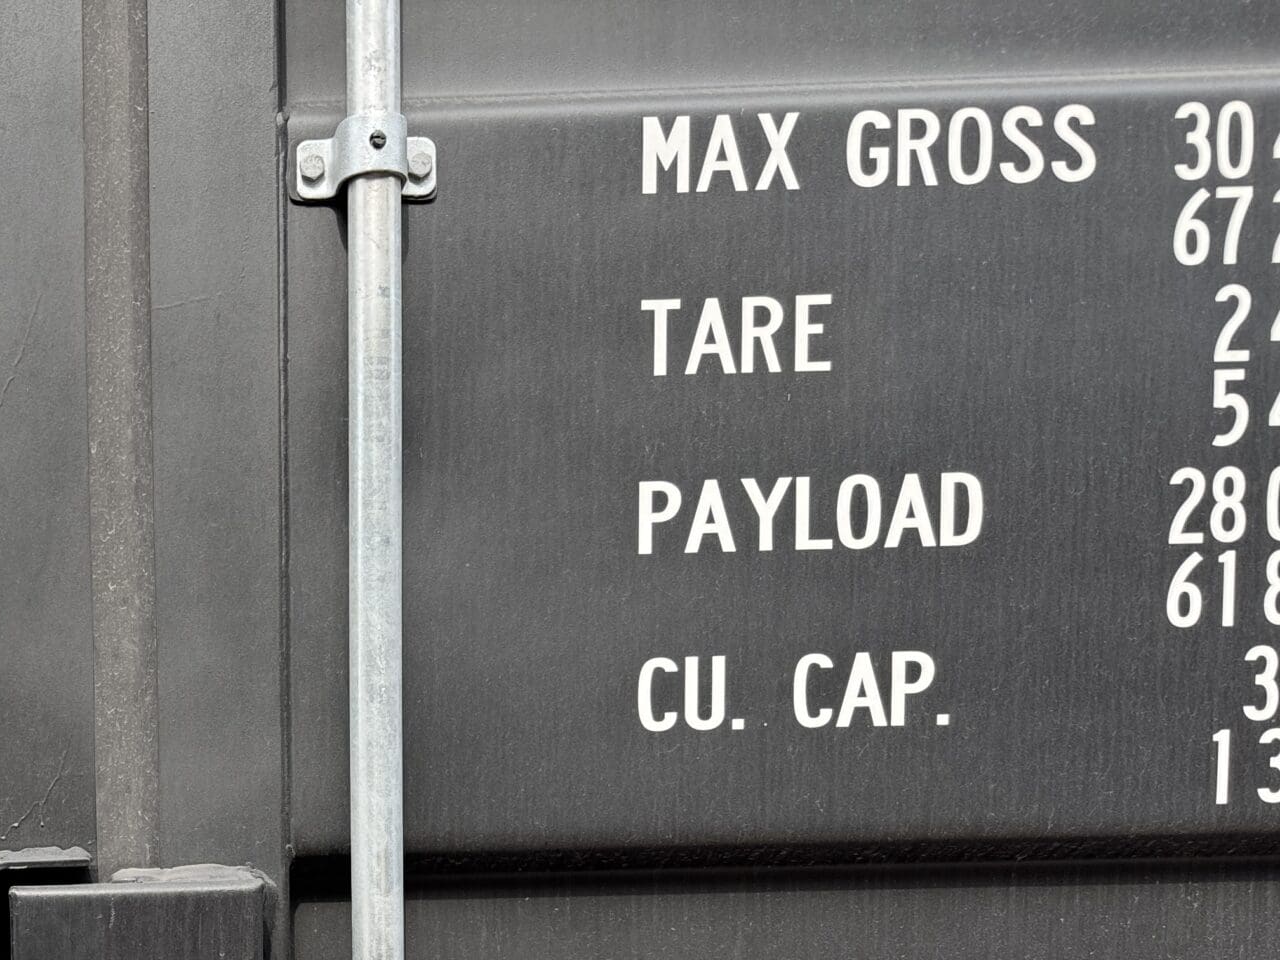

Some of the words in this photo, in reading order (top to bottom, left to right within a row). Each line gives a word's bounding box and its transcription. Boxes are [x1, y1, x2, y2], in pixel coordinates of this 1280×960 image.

[641, 114, 801, 195] MAX
[846, 103, 1098, 188] GROSS
[1173, 100, 1255, 182] 30
[1172, 185, 1255, 267] 67
[640, 293, 833, 377] TARE
[1213, 282, 1253, 363] 2
[1211, 367, 1250, 448] 5
[637, 471, 985, 555] PAYLOAD
[1168, 465, 1248, 545] 28
[1166, 549, 1237, 628] 61
[637, 656, 745, 732] CU.
[793, 650, 951, 729] CAP.
